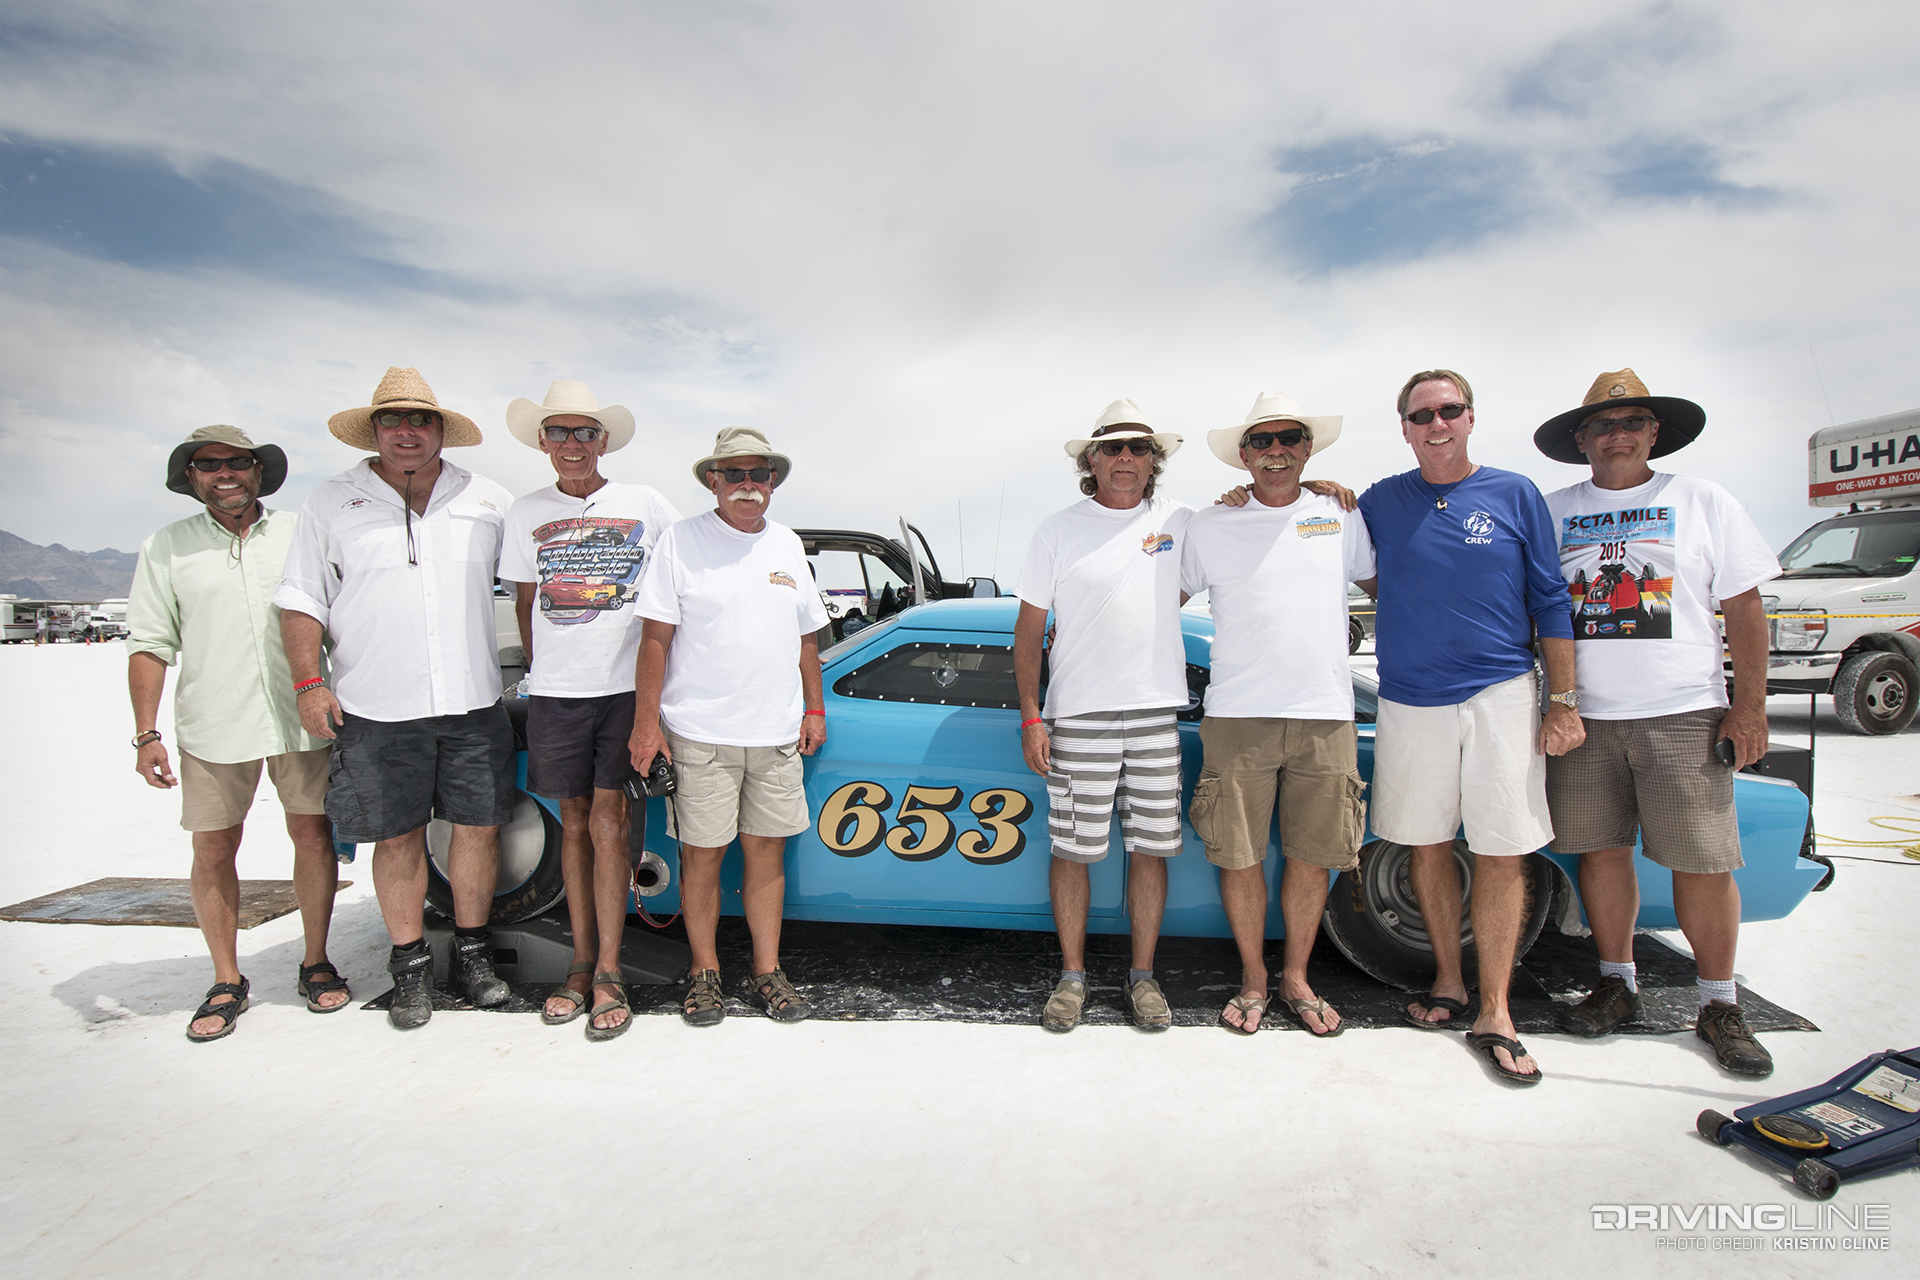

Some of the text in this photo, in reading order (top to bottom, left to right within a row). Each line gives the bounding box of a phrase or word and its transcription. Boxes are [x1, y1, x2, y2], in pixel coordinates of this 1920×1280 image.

[1836, 478, 1878, 491] ONE-WAY
[1879, 477, 1887, 485] &
[1568, 521, 1668, 536] SPEED WEEKEND
[1569, 508, 1668, 530] SCTA MILE
[540, 545, 644, 569] Colorado
[1599, 541, 1626, 561] 2015
[545, 560, 631, 578] Classic
[817, 780, 1034, 865] 653
